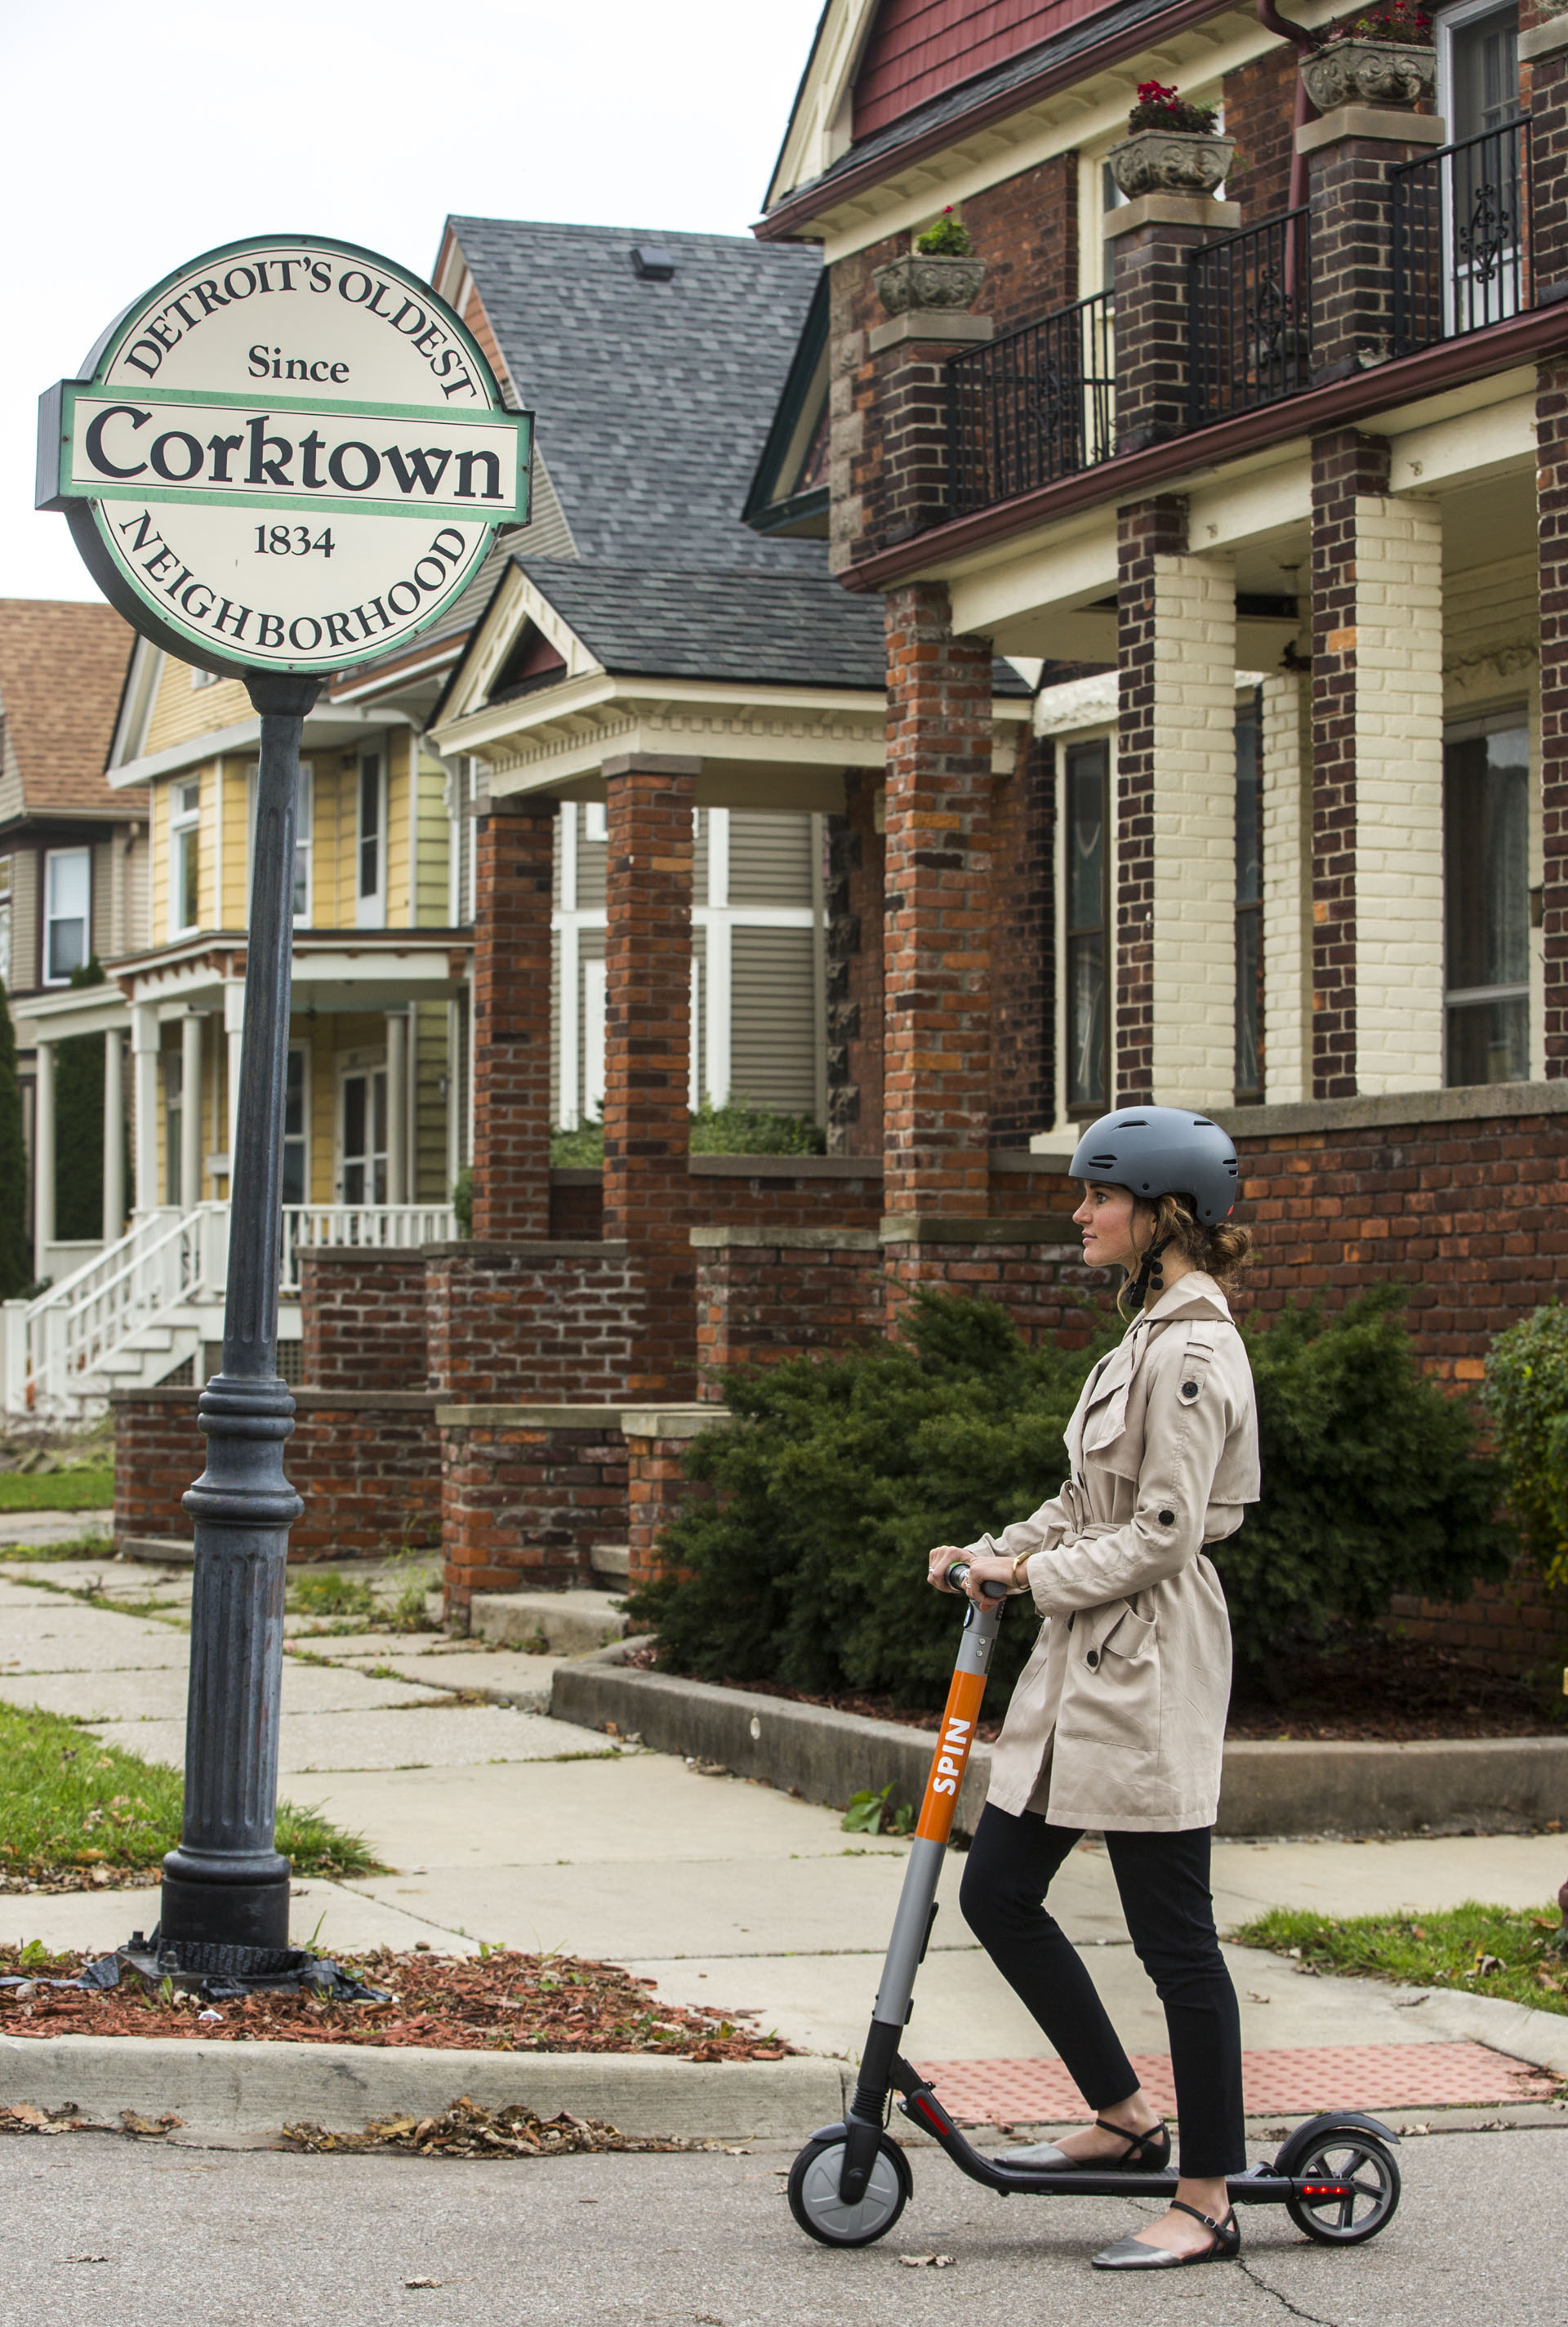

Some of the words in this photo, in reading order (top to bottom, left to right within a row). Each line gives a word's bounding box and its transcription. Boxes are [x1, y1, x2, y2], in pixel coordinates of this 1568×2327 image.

[124, 256, 332, 378] DETROIT'S
[338, 270, 477, 399] OLDEST
[247, 345, 350, 383] Since
[85, 405, 504, 500] Corktown
[118, 510, 466, 650] NEIGHBORHOOD
[254, 524, 336, 558] 1834
[933, 1717, 971, 1796] SPIN
